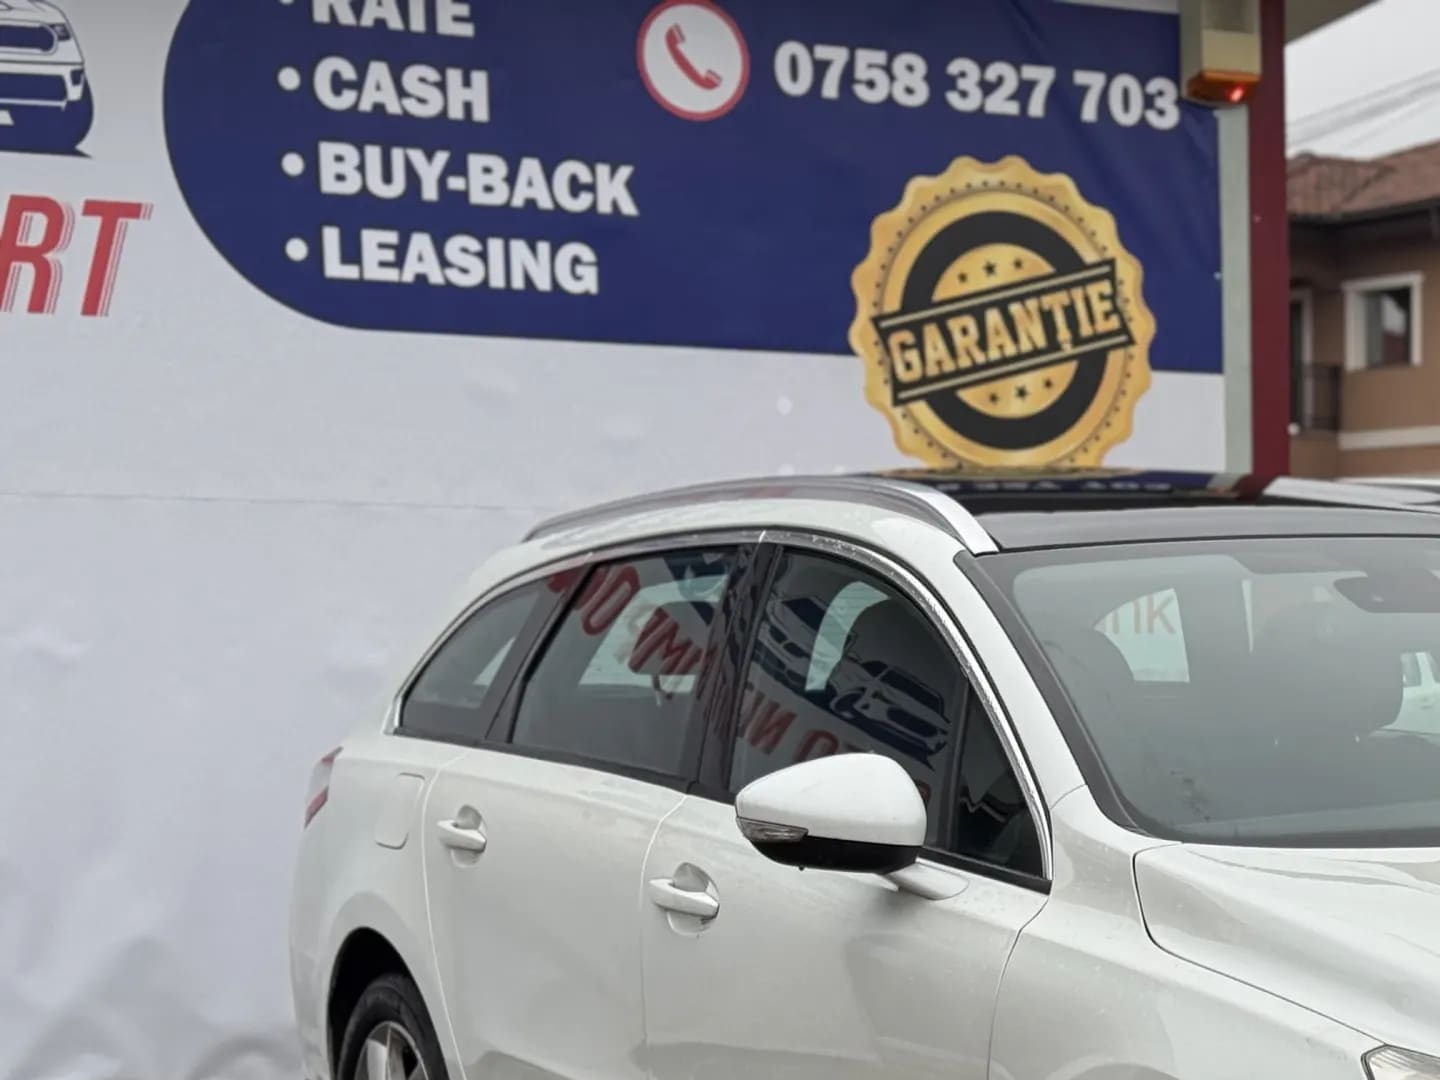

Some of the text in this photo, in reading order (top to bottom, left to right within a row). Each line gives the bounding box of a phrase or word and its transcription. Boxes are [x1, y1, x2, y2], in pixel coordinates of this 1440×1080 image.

[313, 55, 490, 123] CASH
[774, 40, 1180, 130] 0758 327 703
[318, 140, 640, 217] BUY-BACK
[321, 226, 599, 295] LEASING
